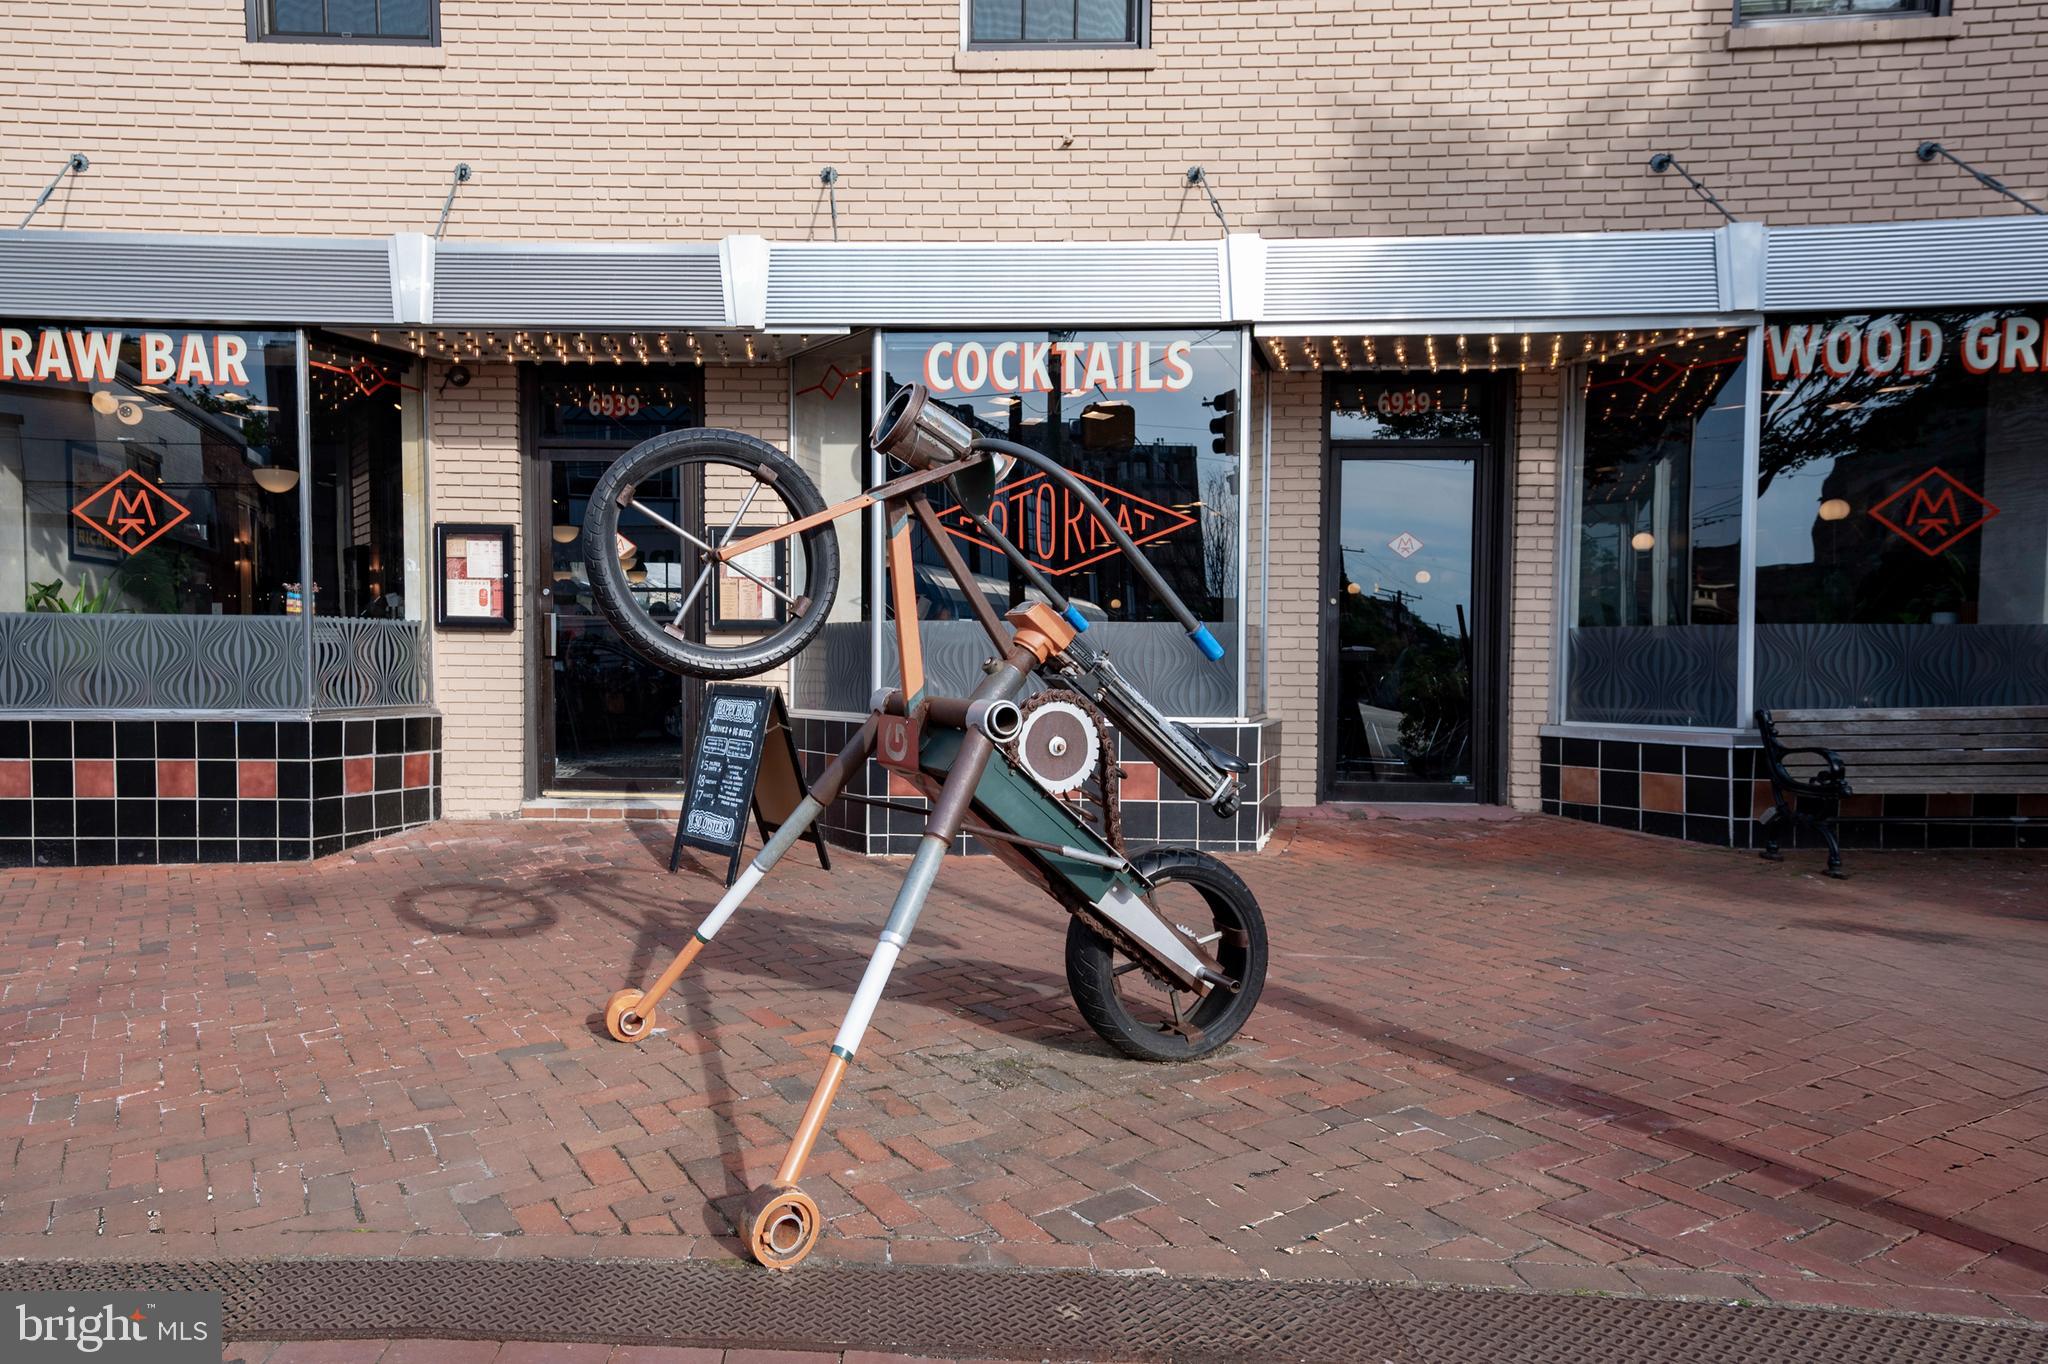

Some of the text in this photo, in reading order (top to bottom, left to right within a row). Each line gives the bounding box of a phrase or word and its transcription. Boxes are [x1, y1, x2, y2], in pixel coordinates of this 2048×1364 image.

[0, 328, 250, 386] RAW BAR
[923, 340, 1193, 394] COCKTAILS
[1766, 316, 2048, 381] WOOD GR
[588, 394, 640, 417] 6939
[1377, 391, 1430, 415] 6939
